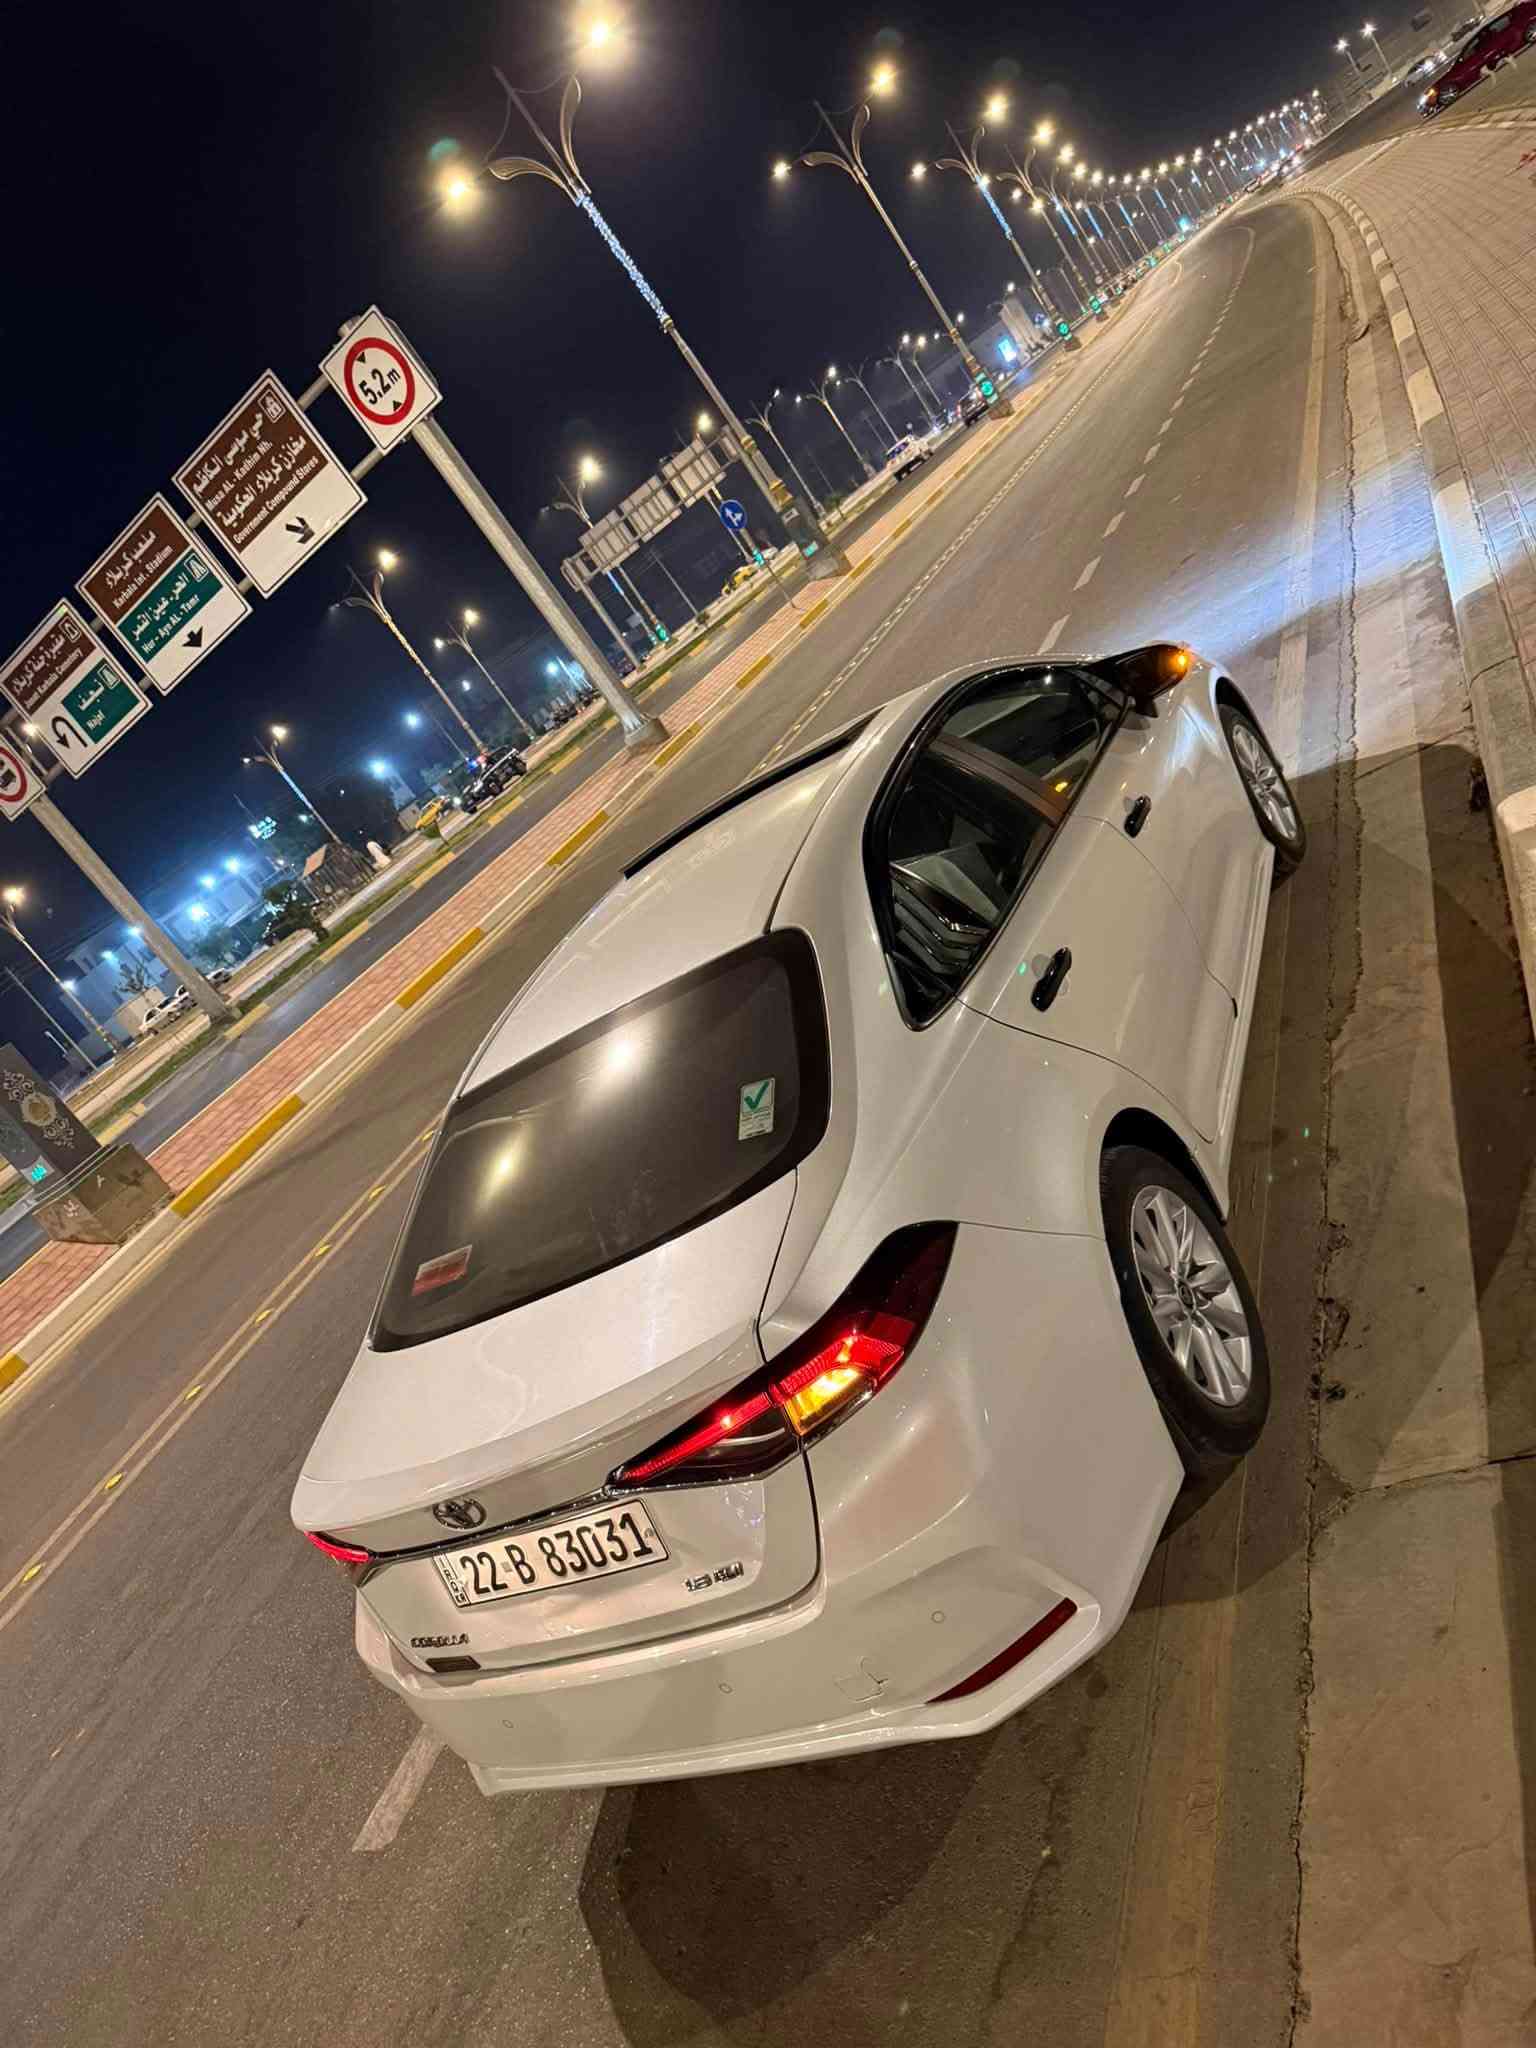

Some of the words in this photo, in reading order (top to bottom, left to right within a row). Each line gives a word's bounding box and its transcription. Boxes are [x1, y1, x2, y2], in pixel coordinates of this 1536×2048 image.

[278, 435, 307, 471] مخازن
[193, 453, 224, 499] الكاظم
[255, 456, 283, 493] كربلاء
[216, 483, 258, 528] الحكومية
[232, 506, 270, 544] Government
[265, 474, 301, 511] Compound
[295, 456, 319, 479] Stores
[105, 551, 134, 590] كربلاء
[145, 545, 174, 574] Stadium
[459, 1551, 508, 1595] 22
[504, 1543, 536, 1585] B
[538, 1512, 653, 1577] 83031
